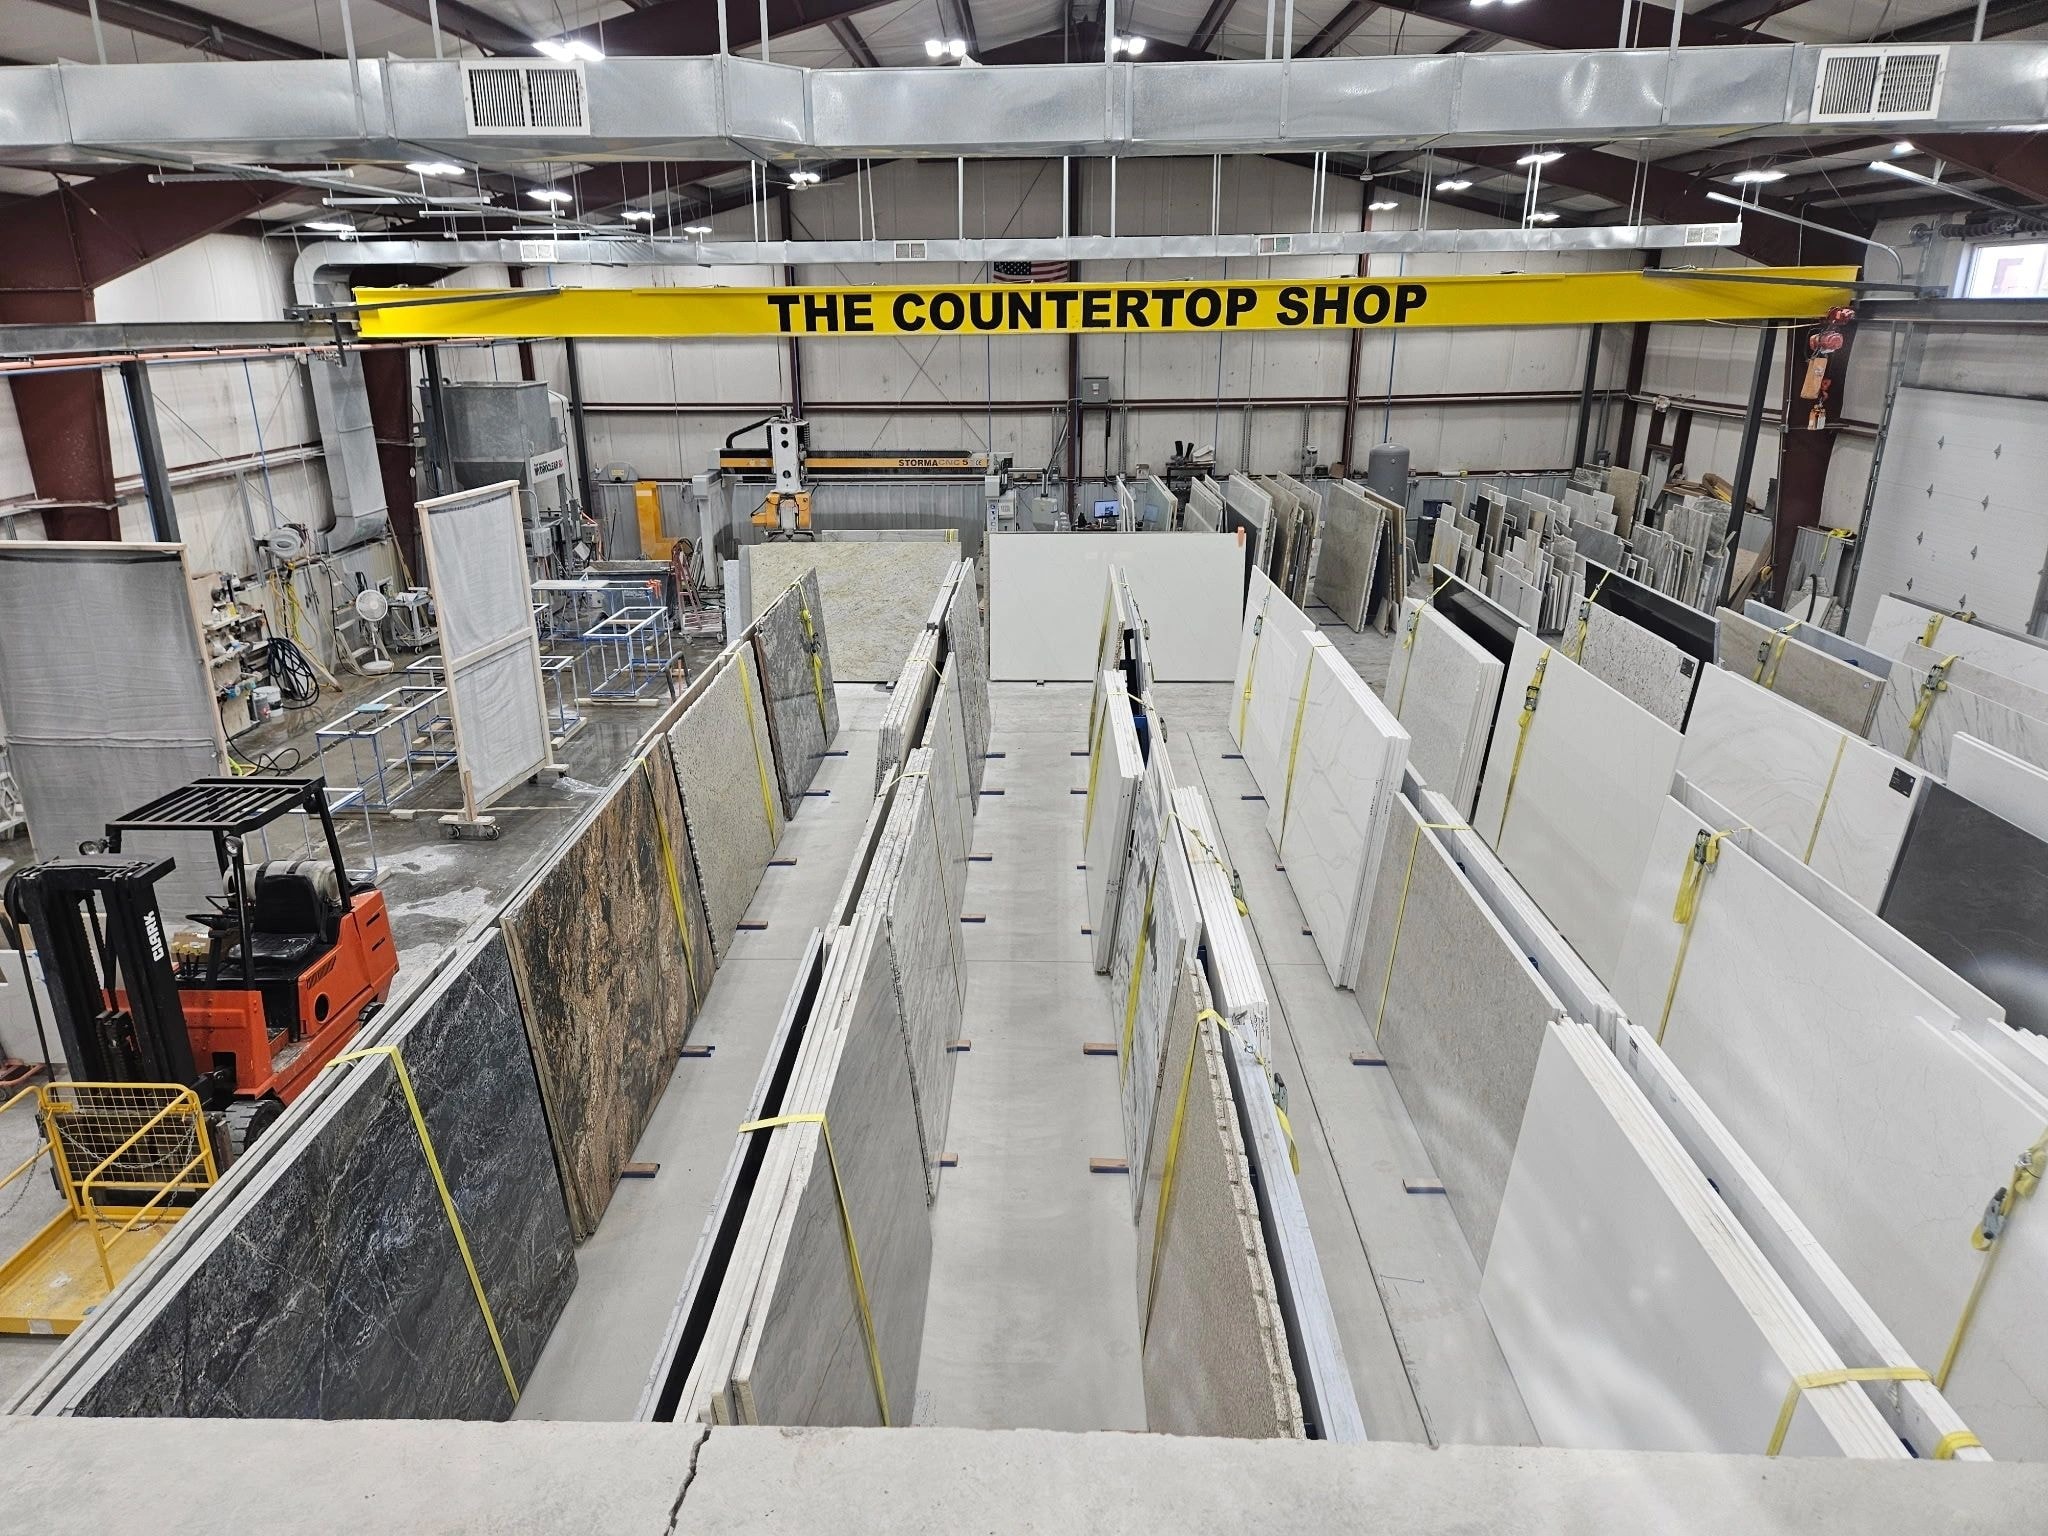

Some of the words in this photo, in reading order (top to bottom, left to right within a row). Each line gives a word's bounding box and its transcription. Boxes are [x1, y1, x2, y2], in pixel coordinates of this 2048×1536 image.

[767, 294, 874, 332] THE
[892, 287, 1258, 332] COUNTERTOP
[1276, 284, 1427, 326] SHOP
[143, 910, 165, 962] CLARK
